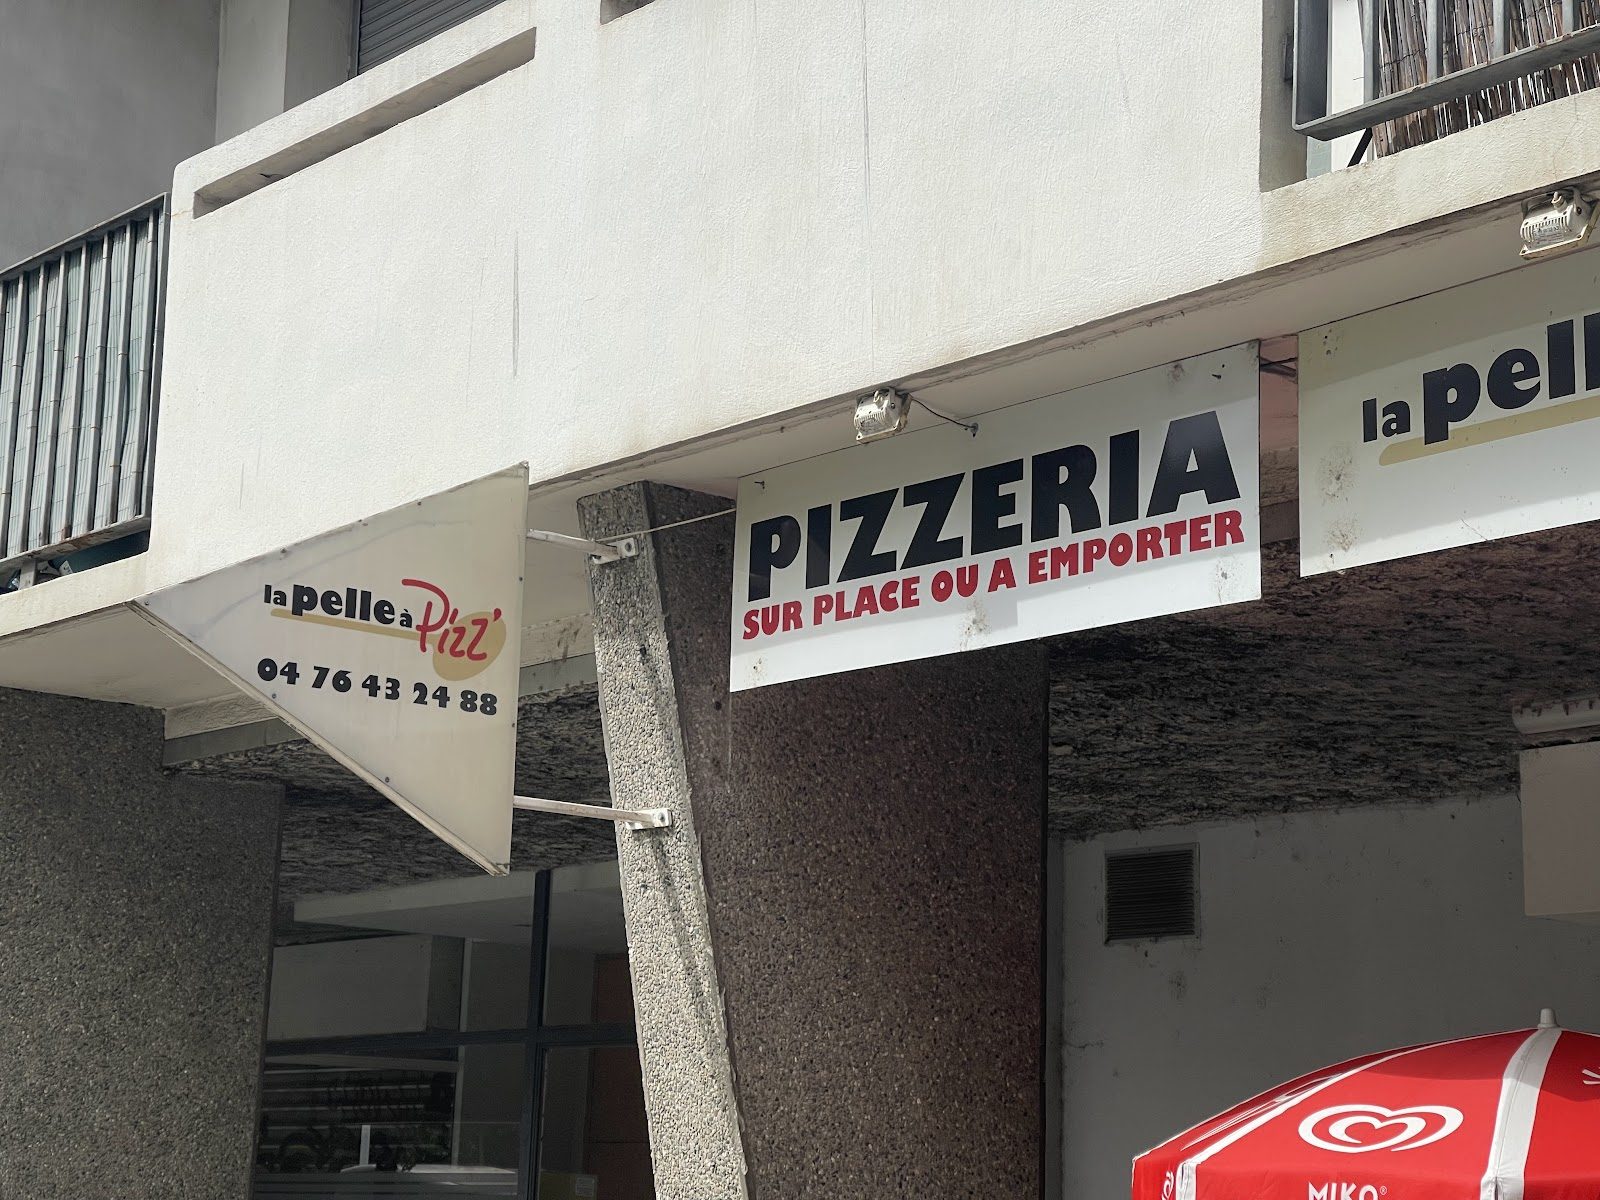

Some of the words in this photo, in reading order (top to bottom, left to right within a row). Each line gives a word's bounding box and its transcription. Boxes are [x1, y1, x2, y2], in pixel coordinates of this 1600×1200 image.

[1362, 397, 1411, 443] la
[747, 410, 1241, 603] PIZZERIA
[742, 600, 803, 640] SUR
[812, 576, 920, 625] PLACE
[930, 565, 979, 602] OU
[988, 558, 1016, 592] A
[1028, 510, 1244, 585] EMPORTER
[263, 584, 287, 607] la
[291, 583, 396, 625] pelle
[399, 608, 413, 629] à
[257, 657, 300, 686] 04
[311, 665, 352, 693] 76
[361, 674, 401, 701] 43
[412, 682, 451, 709] 24
[459, 689, 498, 716] 88
